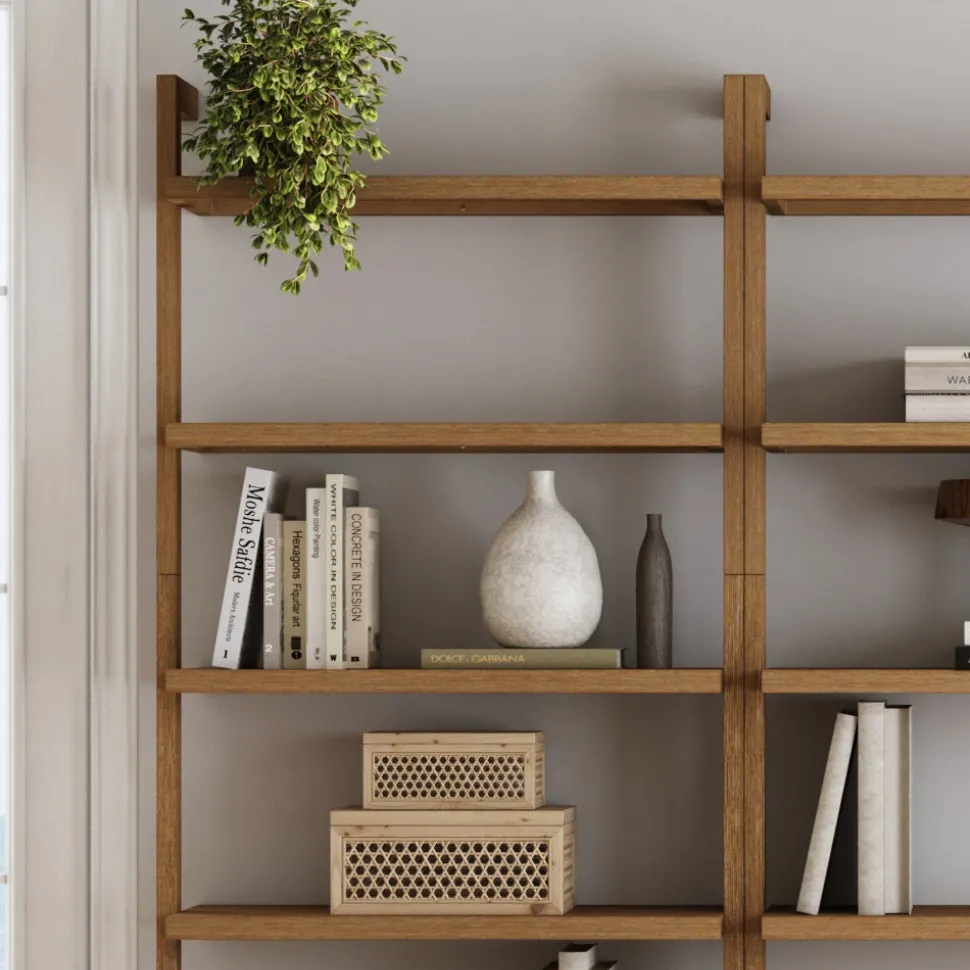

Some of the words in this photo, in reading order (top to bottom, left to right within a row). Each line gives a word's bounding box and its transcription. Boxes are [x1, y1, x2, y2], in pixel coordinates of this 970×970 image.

[241, 483, 265, 534] Moshe
[351, 513, 362, 568] CONCRETE
[232, 537, 256, 584] Safdie
[289, 530, 303, 579] Hexagons
[330, 570, 337, 581] IN
[351, 572, 362, 583] IN
[351, 586, 362, 622] DESIGN
[292, 616, 301, 628] art
[265, 644, 273, 652] 2
[431, 655, 465, 663] DOLCE
[471, 655, 525, 663] GABBANA
